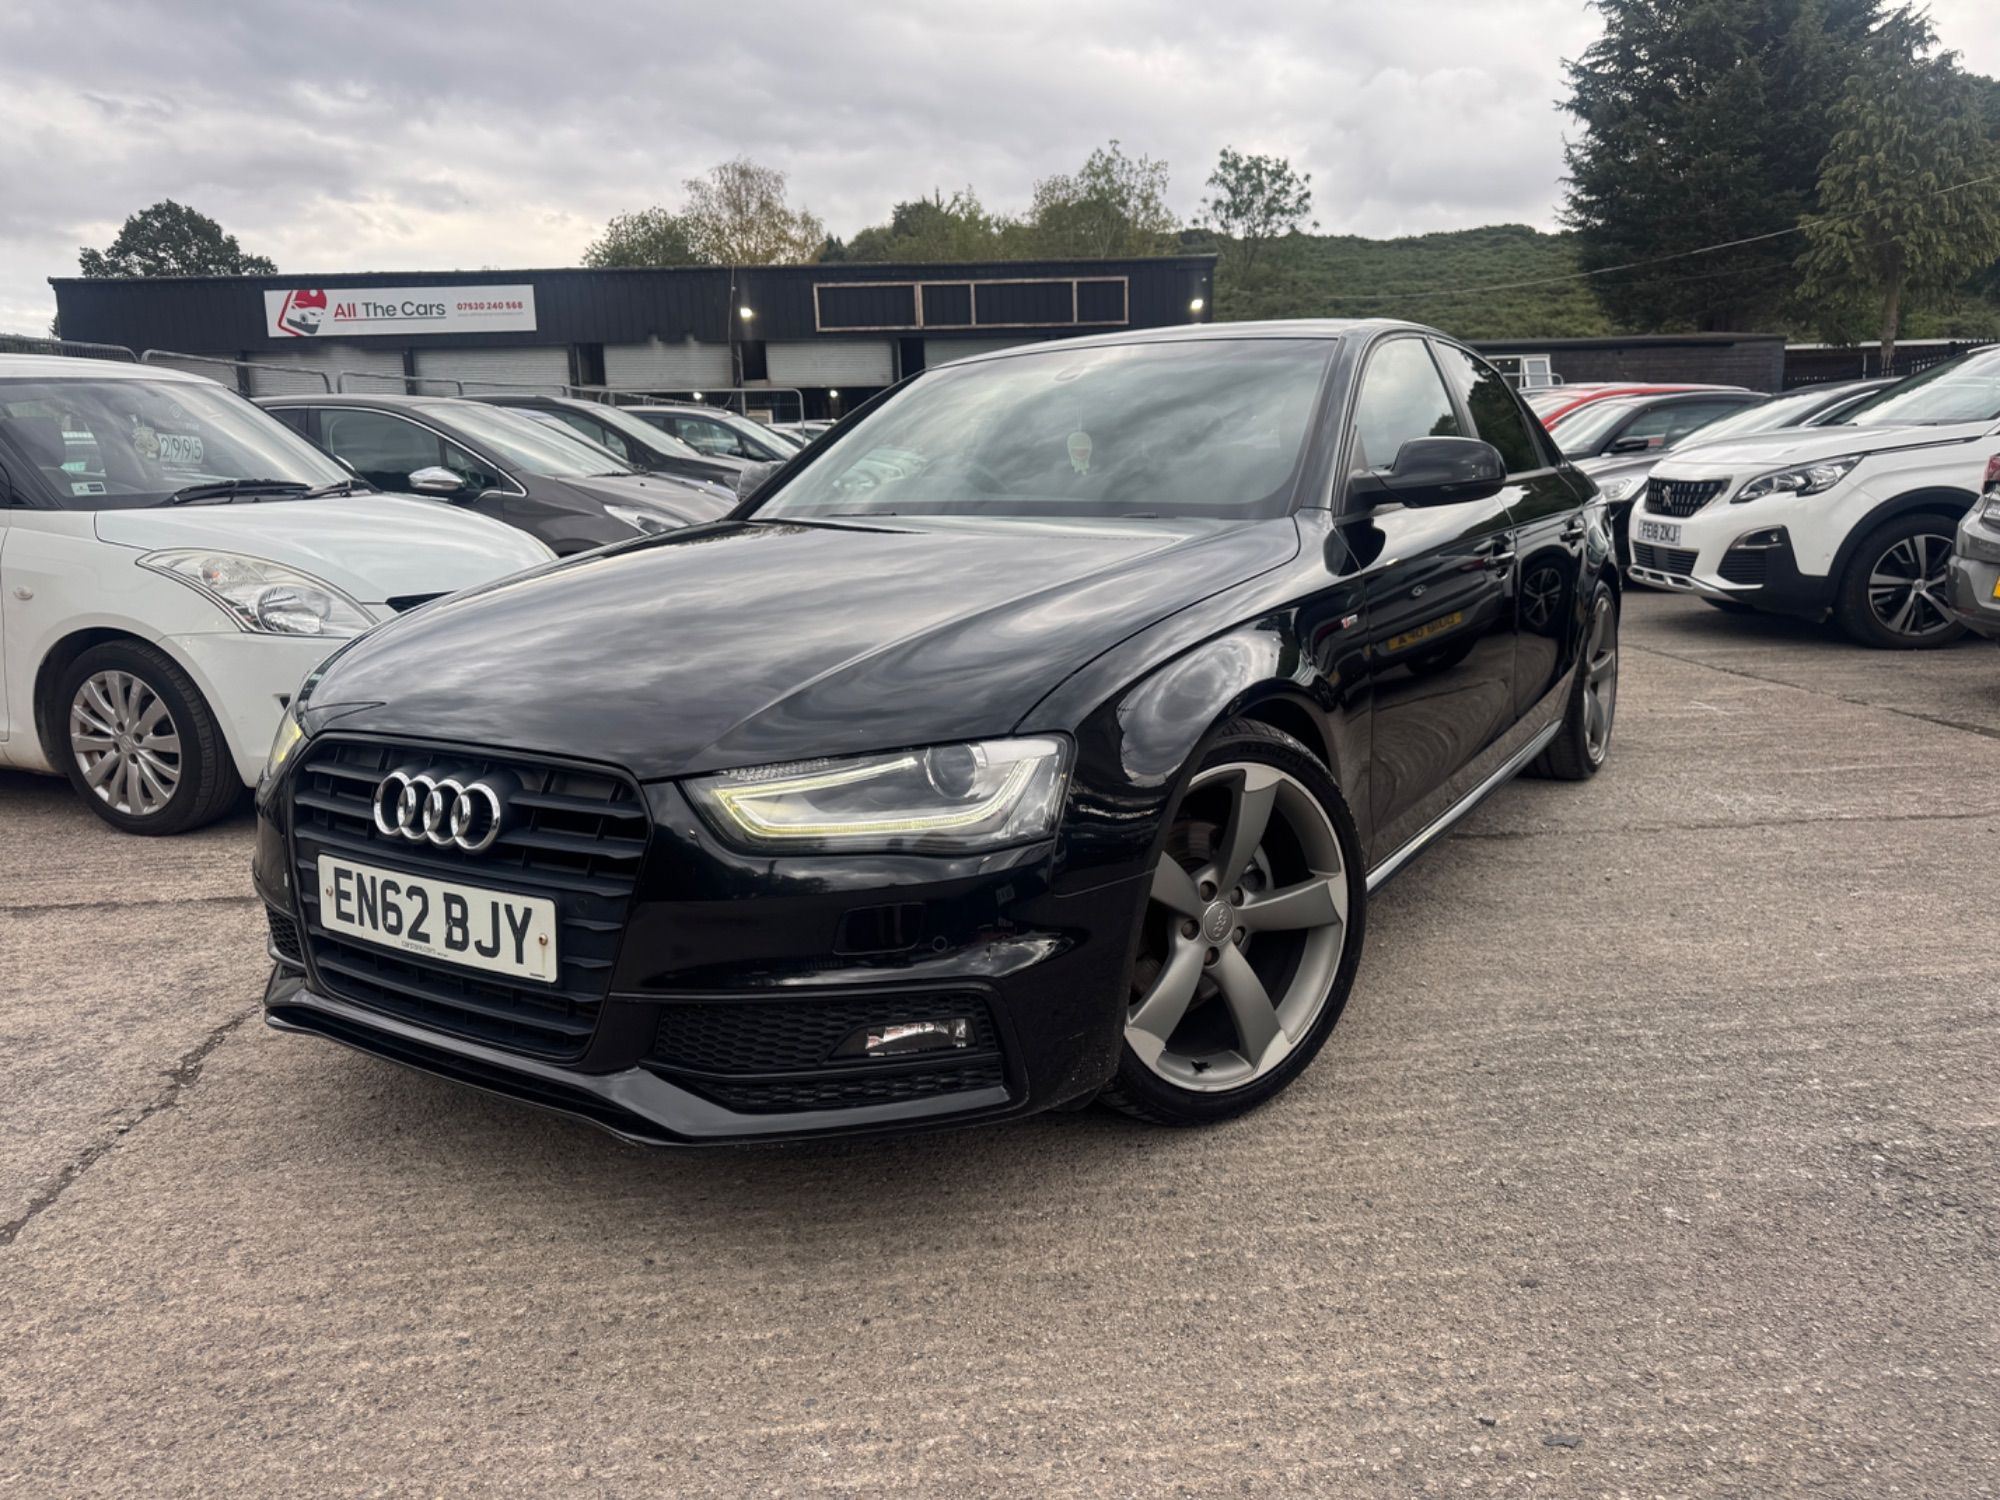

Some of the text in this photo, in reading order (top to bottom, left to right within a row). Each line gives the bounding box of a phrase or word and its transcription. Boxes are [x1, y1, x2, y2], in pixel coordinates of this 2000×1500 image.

[334, 301, 446, 318] All The Cars
[486, 302, 504, 310] 240
[160, 436, 202, 460] 2995
[1660, 524, 1677, 542] ZKJ
[333, 866, 533, 965] EN62 BJY
